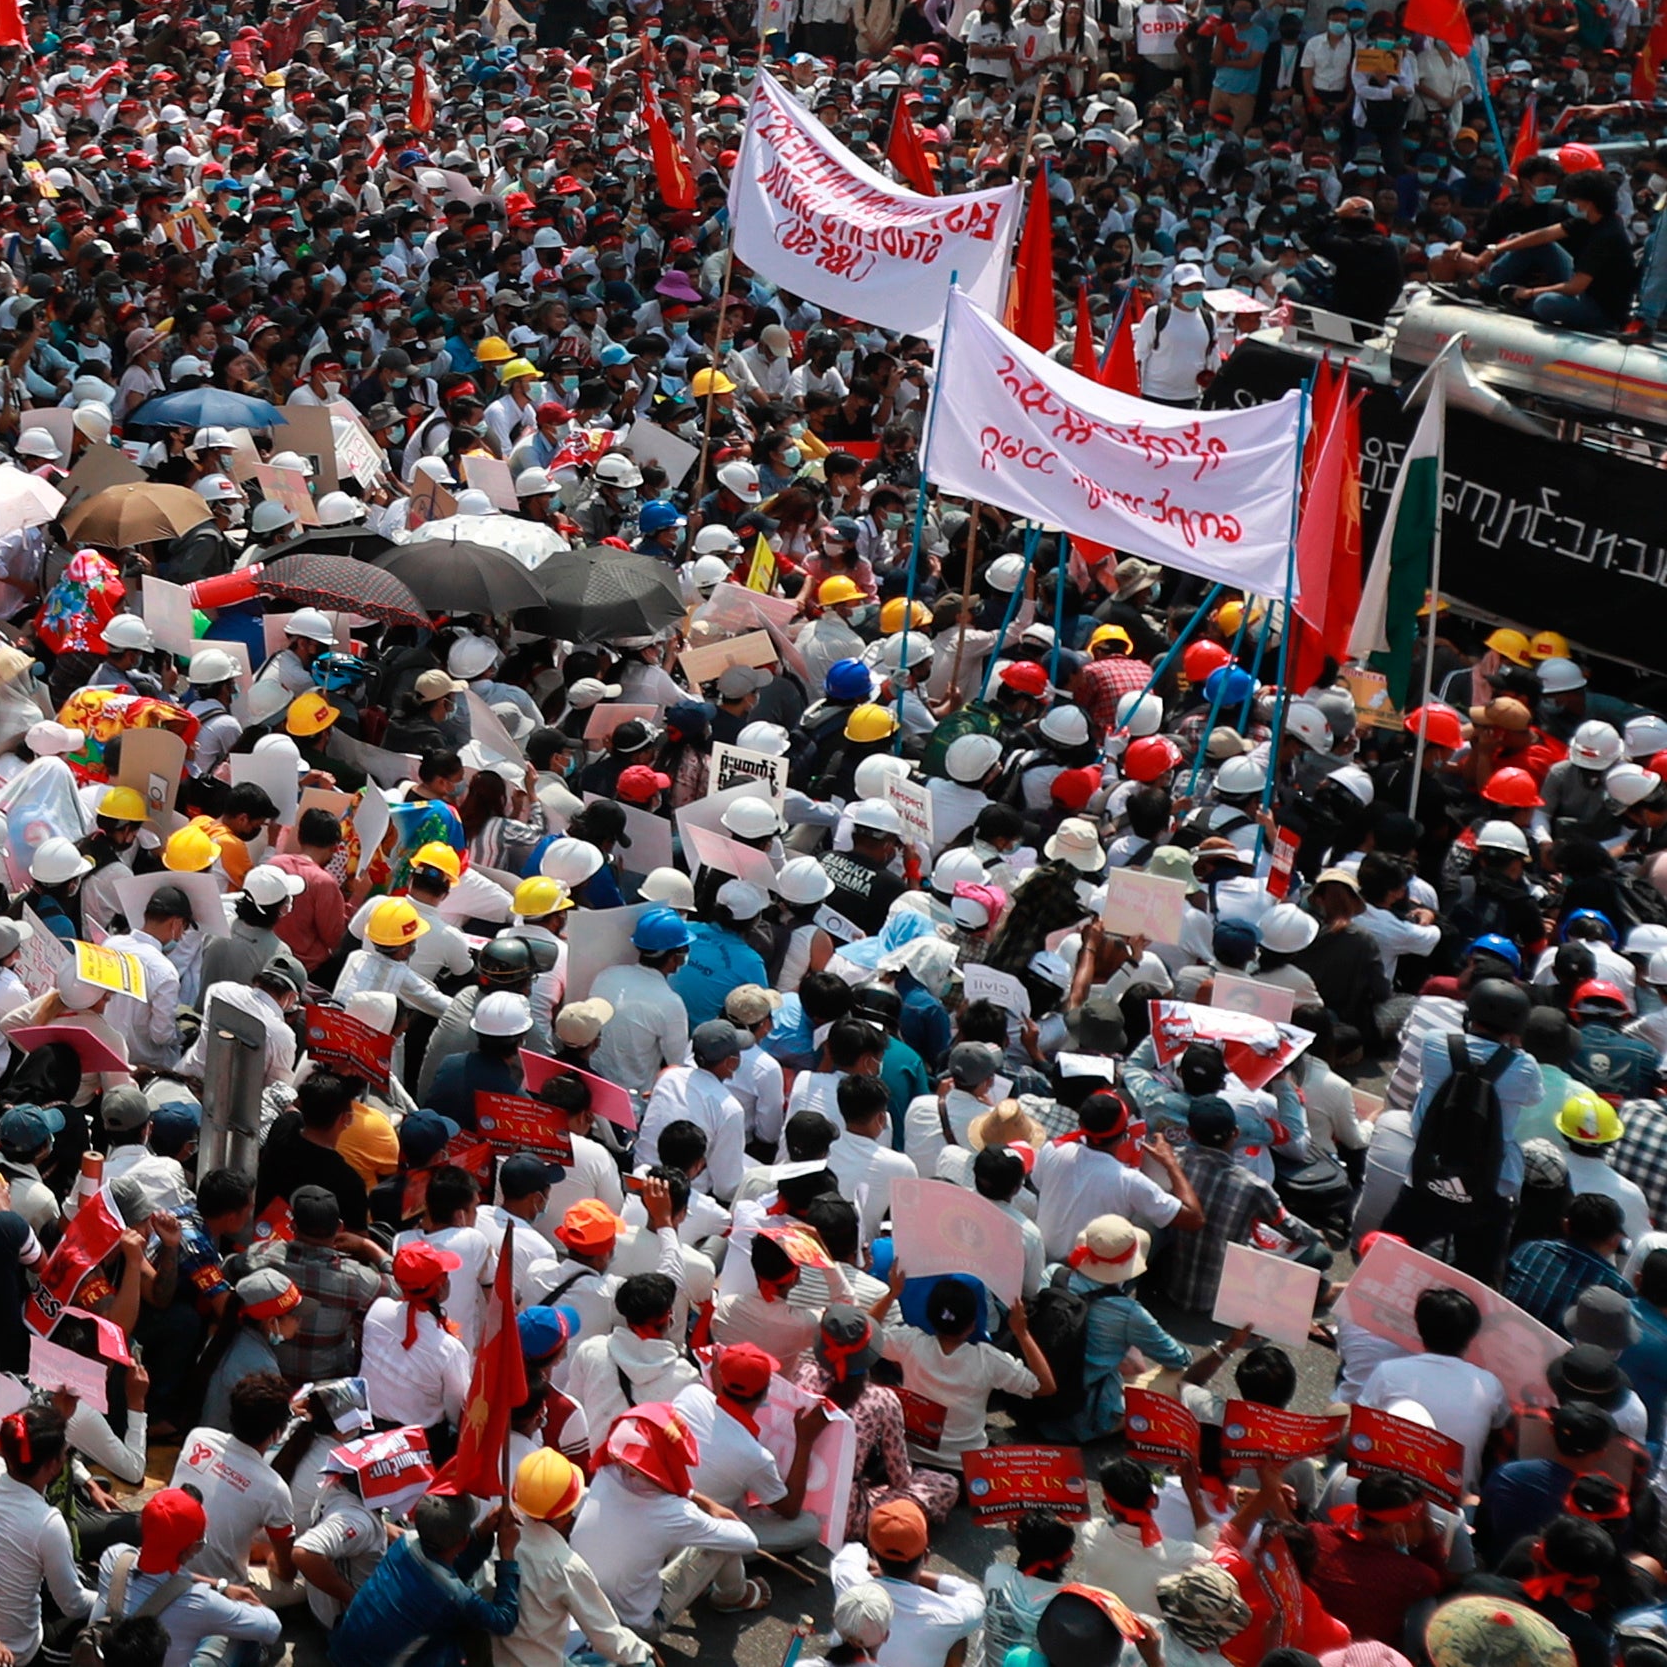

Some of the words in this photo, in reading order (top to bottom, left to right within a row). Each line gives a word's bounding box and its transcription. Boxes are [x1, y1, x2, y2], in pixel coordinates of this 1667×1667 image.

[1141, 20, 1188, 35] CRPH
[889, 784, 924, 811] Respect
[822, 853, 877, 883] BANGKIT
[825, 866, 872, 898] ERSAMA
[325, 1029, 345, 1043] UN
[496, 1118, 515, 1132] UN
[538, 1123, 558, 1137] US
[1148, 1418, 1172, 1433] UN
[1246, 1427, 1269, 1440] UN
[1301, 1434, 1326, 1446] US
[979, 1450, 993, 1459] We
[994, 1449, 1034, 1459] Myanmar
[1034, 1448, 1061, 1459] People
[1373, 1438, 1395, 1454] UN
[1424, 1455, 1447, 1473] US
[988, 1476, 1013, 1490] UN
[1021, 1475, 1036, 1489] &
[1042, 1476, 1062, 1489] US
[978, 1501, 1009, 1514] Terrorist
[1011, 1499, 1073, 1512] Dictatorship
